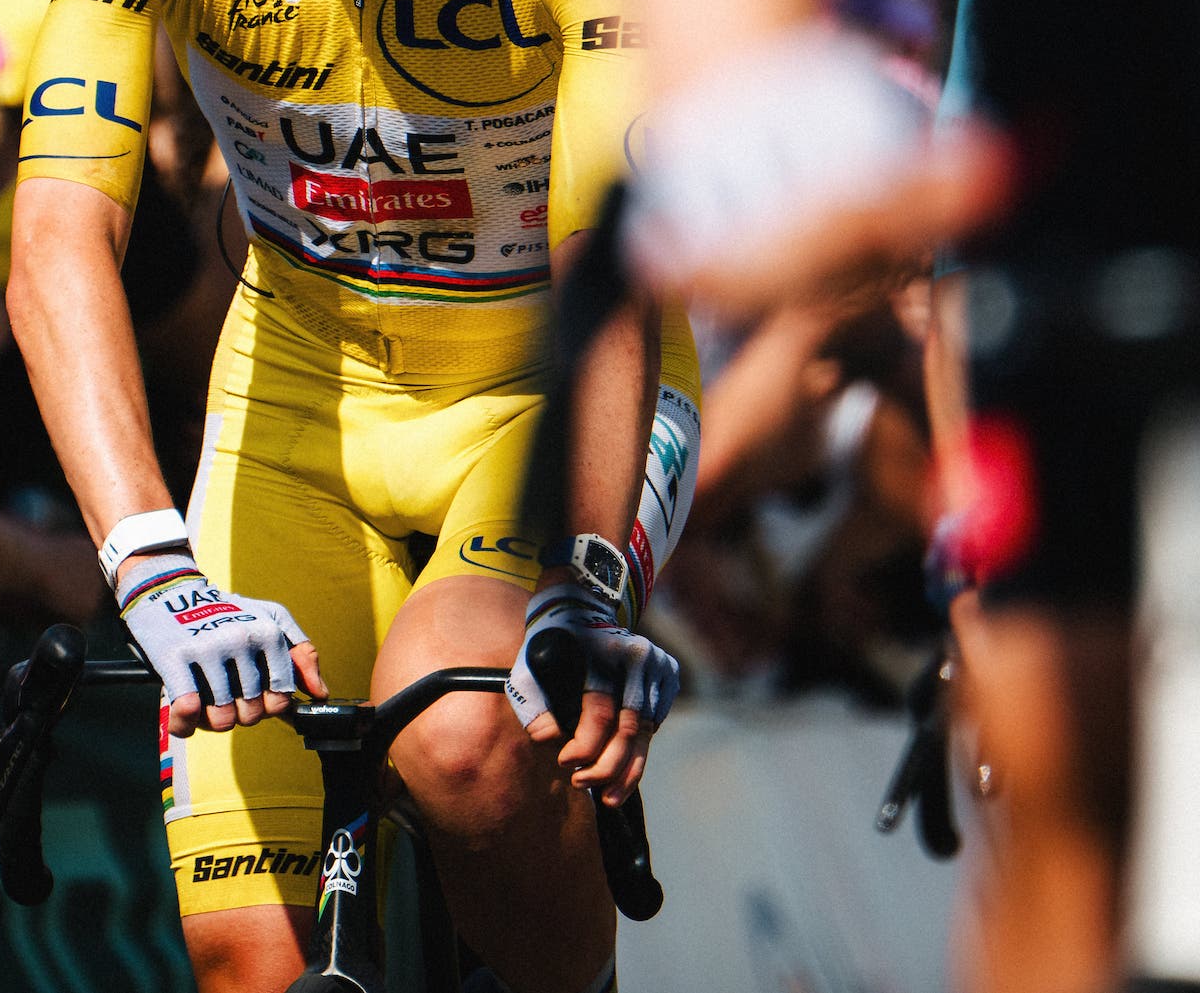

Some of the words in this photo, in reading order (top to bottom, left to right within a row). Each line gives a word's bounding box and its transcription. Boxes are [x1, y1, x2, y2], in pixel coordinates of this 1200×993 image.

[196, 32, 334, 90] Santini
[21, 77, 142, 134] CL
[464, 120, 478, 131] T.
[280, 117, 464, 174] UAE
[305, 179, 452, 213] Emirates
[527, 179, 550, 193] IH
[303, 217, 476, 265] XRG
[517, 243, 550, 254] PIS
[470, 535, 540, 562] LC
[187, 614, 257, 637] XRG
[311, 705, 340, 713] wahoo
[192, 848, 323, 883] Santini
